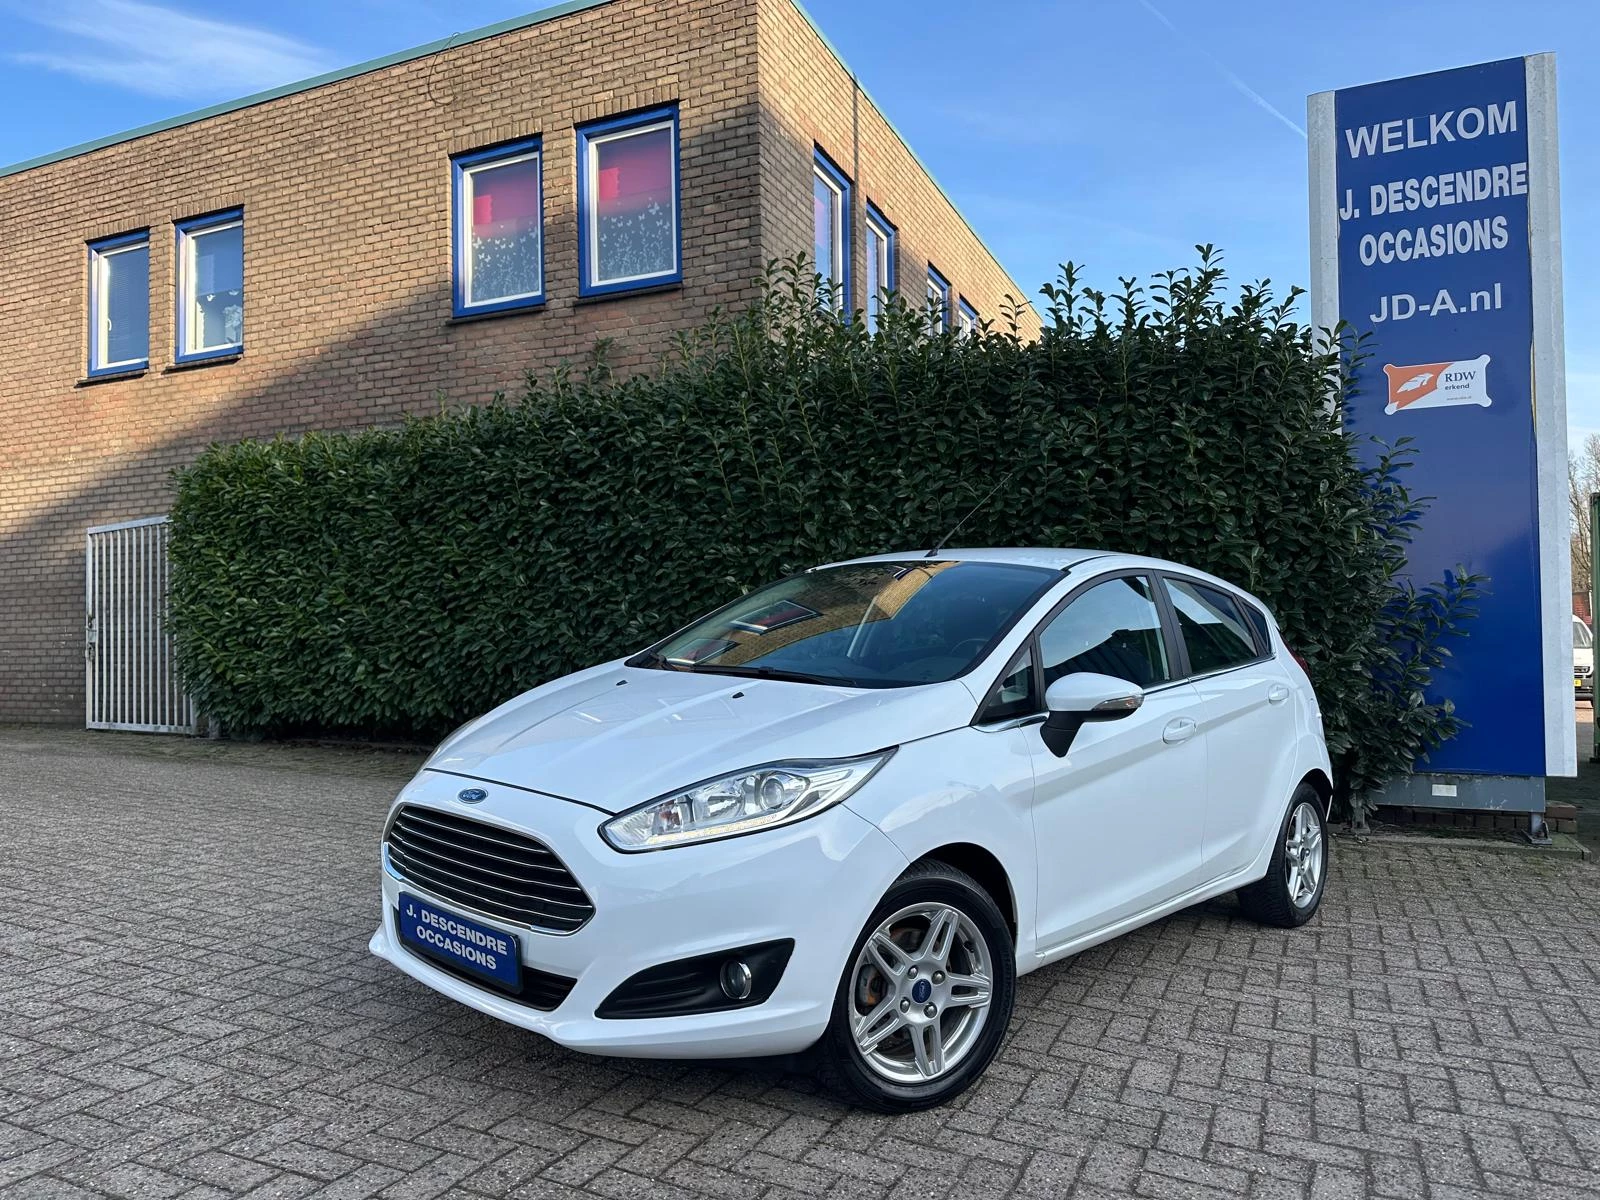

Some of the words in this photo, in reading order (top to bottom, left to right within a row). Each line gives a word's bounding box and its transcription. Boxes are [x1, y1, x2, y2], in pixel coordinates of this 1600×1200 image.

[1345, 101, 1517, 158] WELKOM
[1339, 189, 1360, 221] J.
[1371, 162, 1528, 216] DESCENDRE
[1359, 215, 1508, 266] OCCASIONS
[1369, 283, 1502, 323] JD-A.nl
[1445, 370, 1476, 382] RDW
[1445, 382, 1470, 390] erkend
[406, 904, 417, 919] J.
[421, 909, 508, 956] DESCENDRE
[416, 925, 497, 970] OCCASIONS
